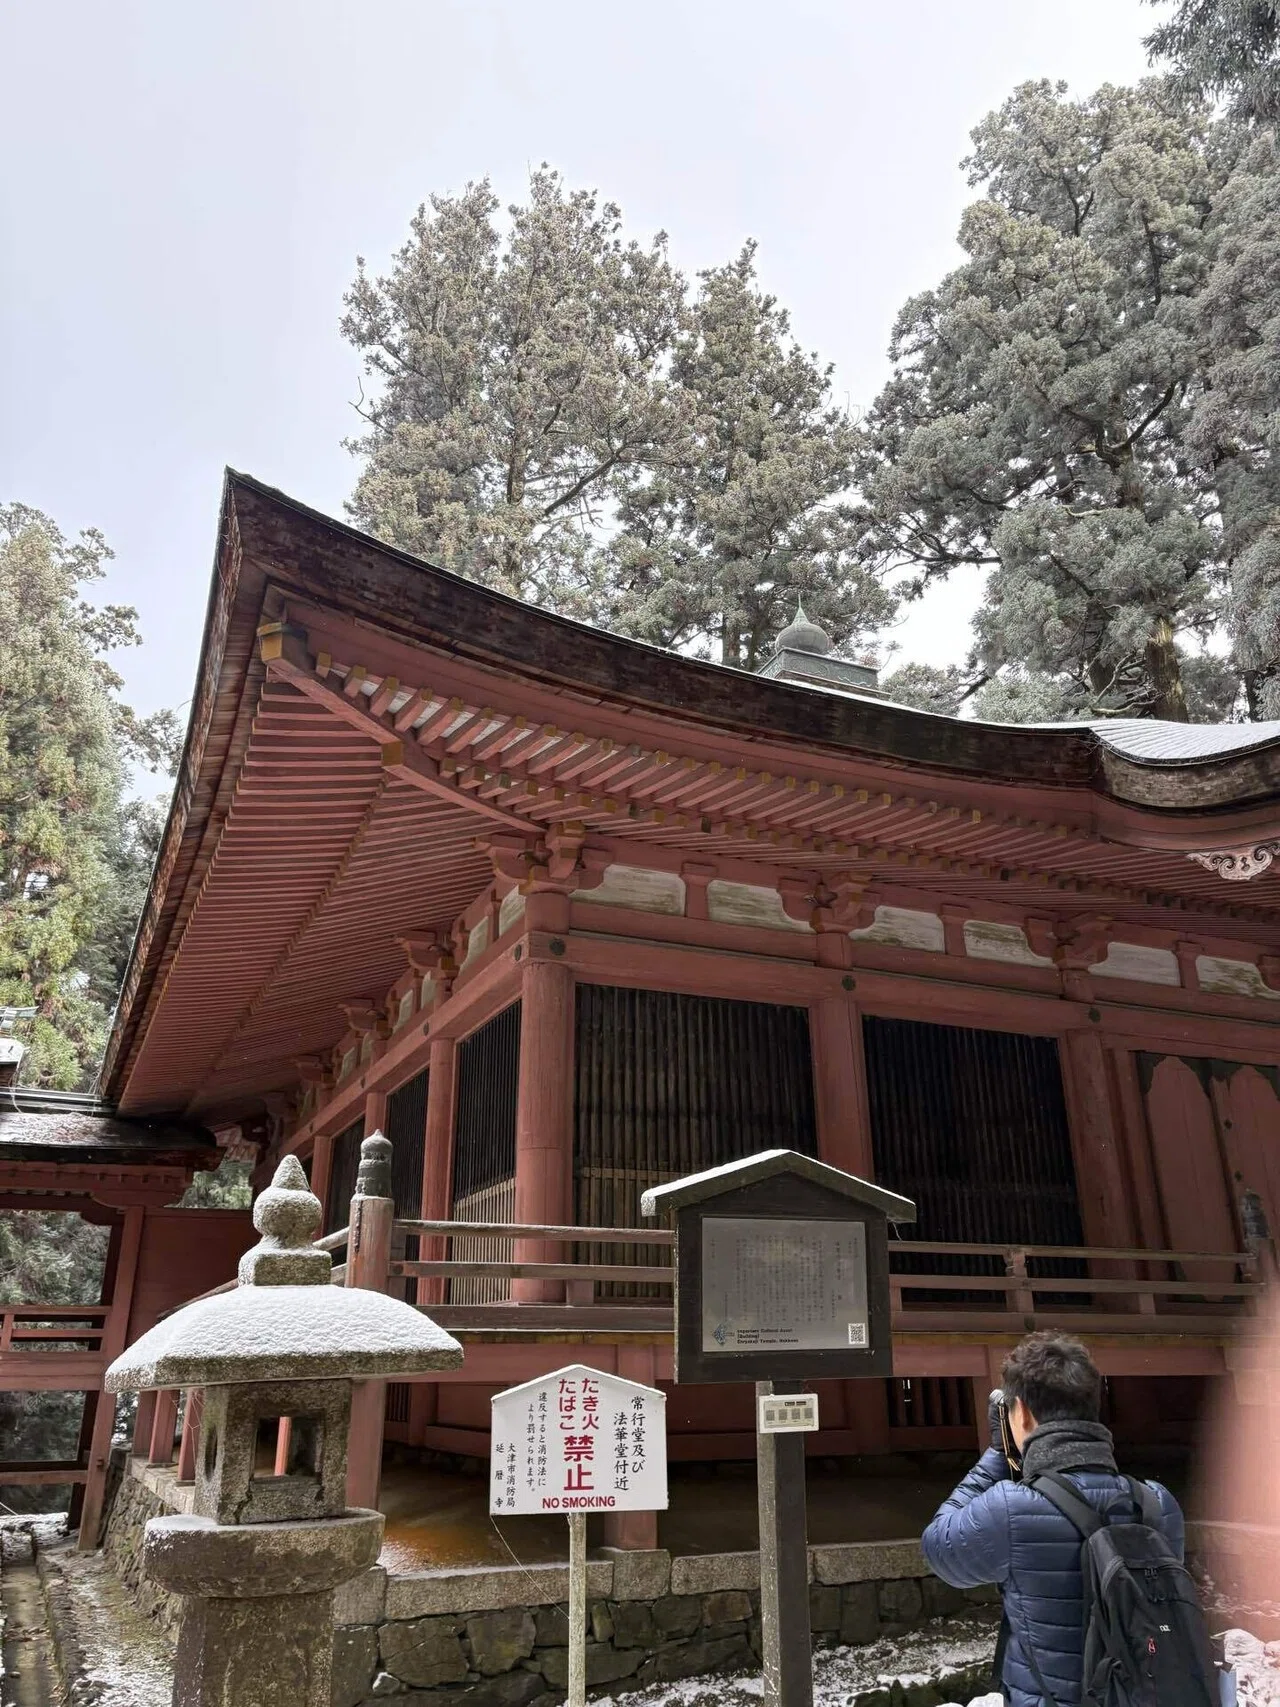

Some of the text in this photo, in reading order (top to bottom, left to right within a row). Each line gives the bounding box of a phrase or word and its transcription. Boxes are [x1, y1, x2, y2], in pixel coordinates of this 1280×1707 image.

[559, 1379, 576, 1430] たばこ
[582, 1378, 599, 1430] たき火
[631, 1396, 646, 1473] 常行堂及び
[526, 1403, 535, 1492] より罰せられます。
[537, 1392, 547, 1486] 違反すると消防法に
[564, 1435, 594, 1490] 禁止
[614, 1412, 630, 1491] 法華堂付近
[506, 1443, 516, 1508] 大津市消防局
[542, 1495, 616, 1508] NO SMOKING
